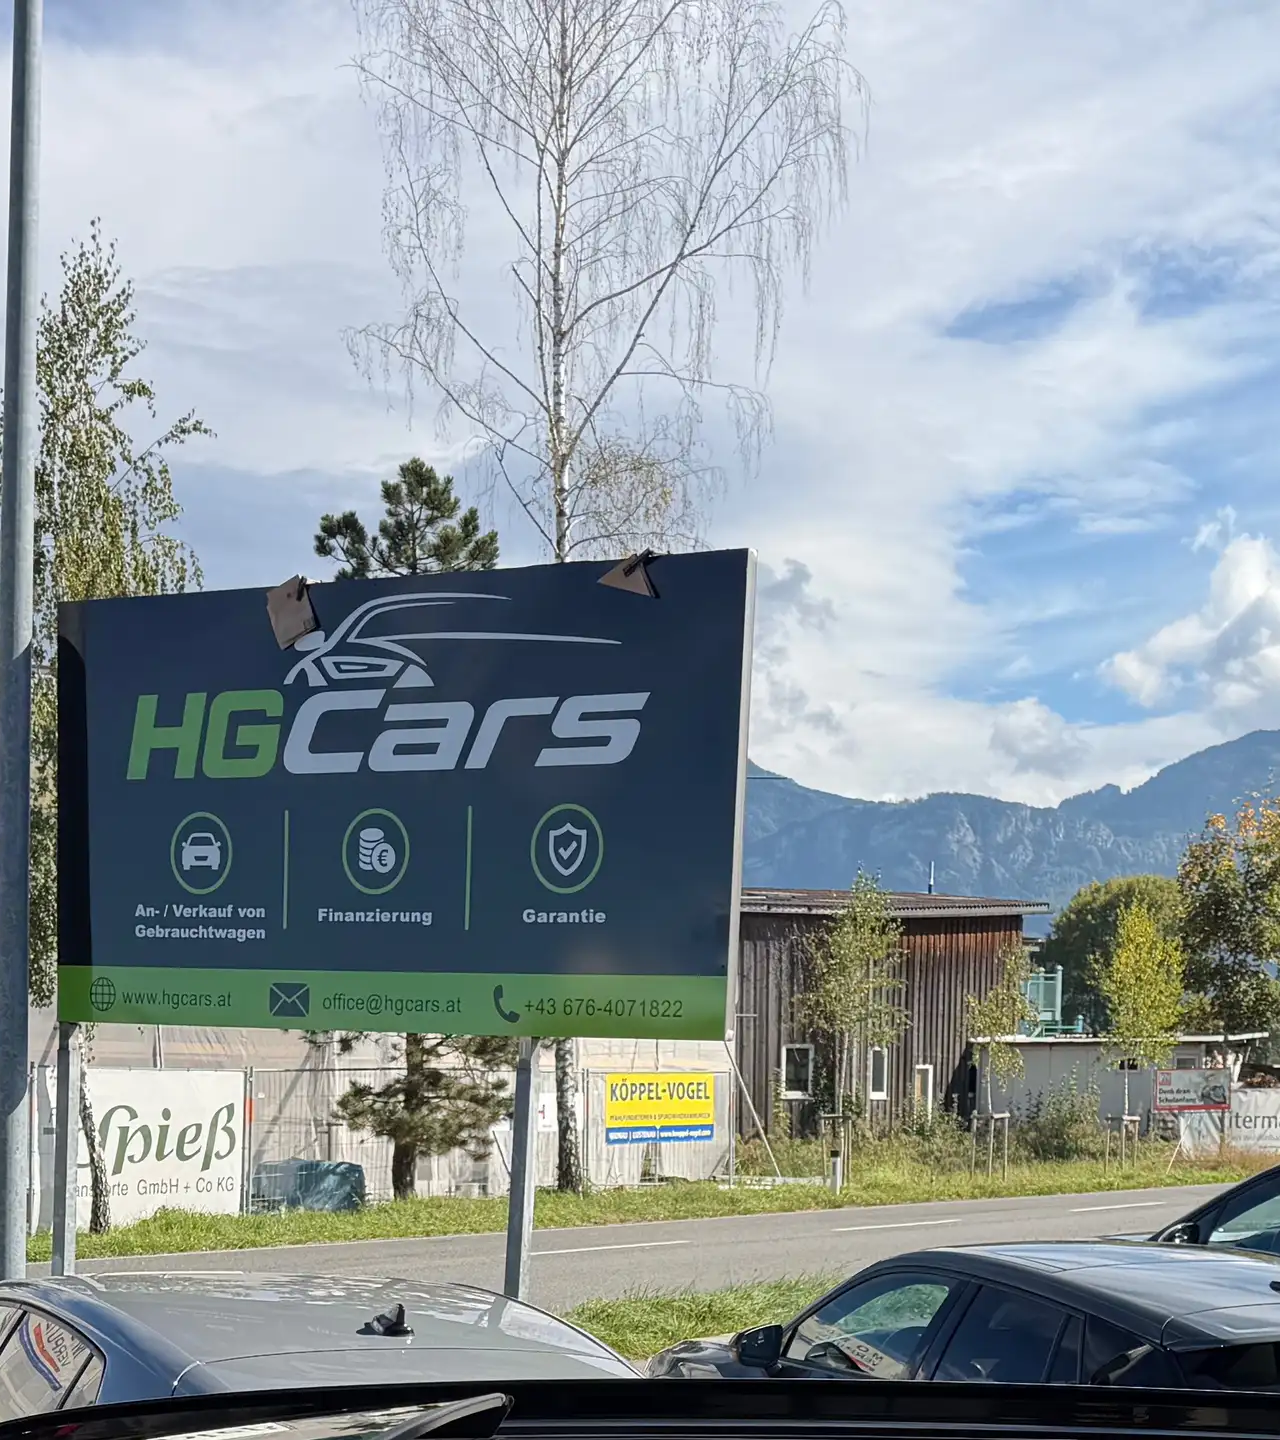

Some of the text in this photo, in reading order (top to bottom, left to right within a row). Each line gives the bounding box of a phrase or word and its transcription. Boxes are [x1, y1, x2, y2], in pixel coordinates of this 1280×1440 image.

[135, 904, 160, 918] An-
[172, 904, 234, 919] Verkauf
[238, 906, 266, 918] von
[317, 908, 434, 926] Finanzierung
[522, 908, 607, 923] Garantie
[135, 925, 266, 942] Gebrauchtwagen
[122, 989, 232, 1010] www.hgcars.at
[322, 993, 462, 1016] office@hgcars.at
[524, 998, 683, 1019] +43 676-4071822
[610, 1078, 710, 1102] KÖPPEL-VOGEL
[136, 1178, 179, 1196] GmbH
[183, 1182, 191, 1193] +
[195, 1176, 213, 1193] Co
[217, 1176, 235, 1192] KG
